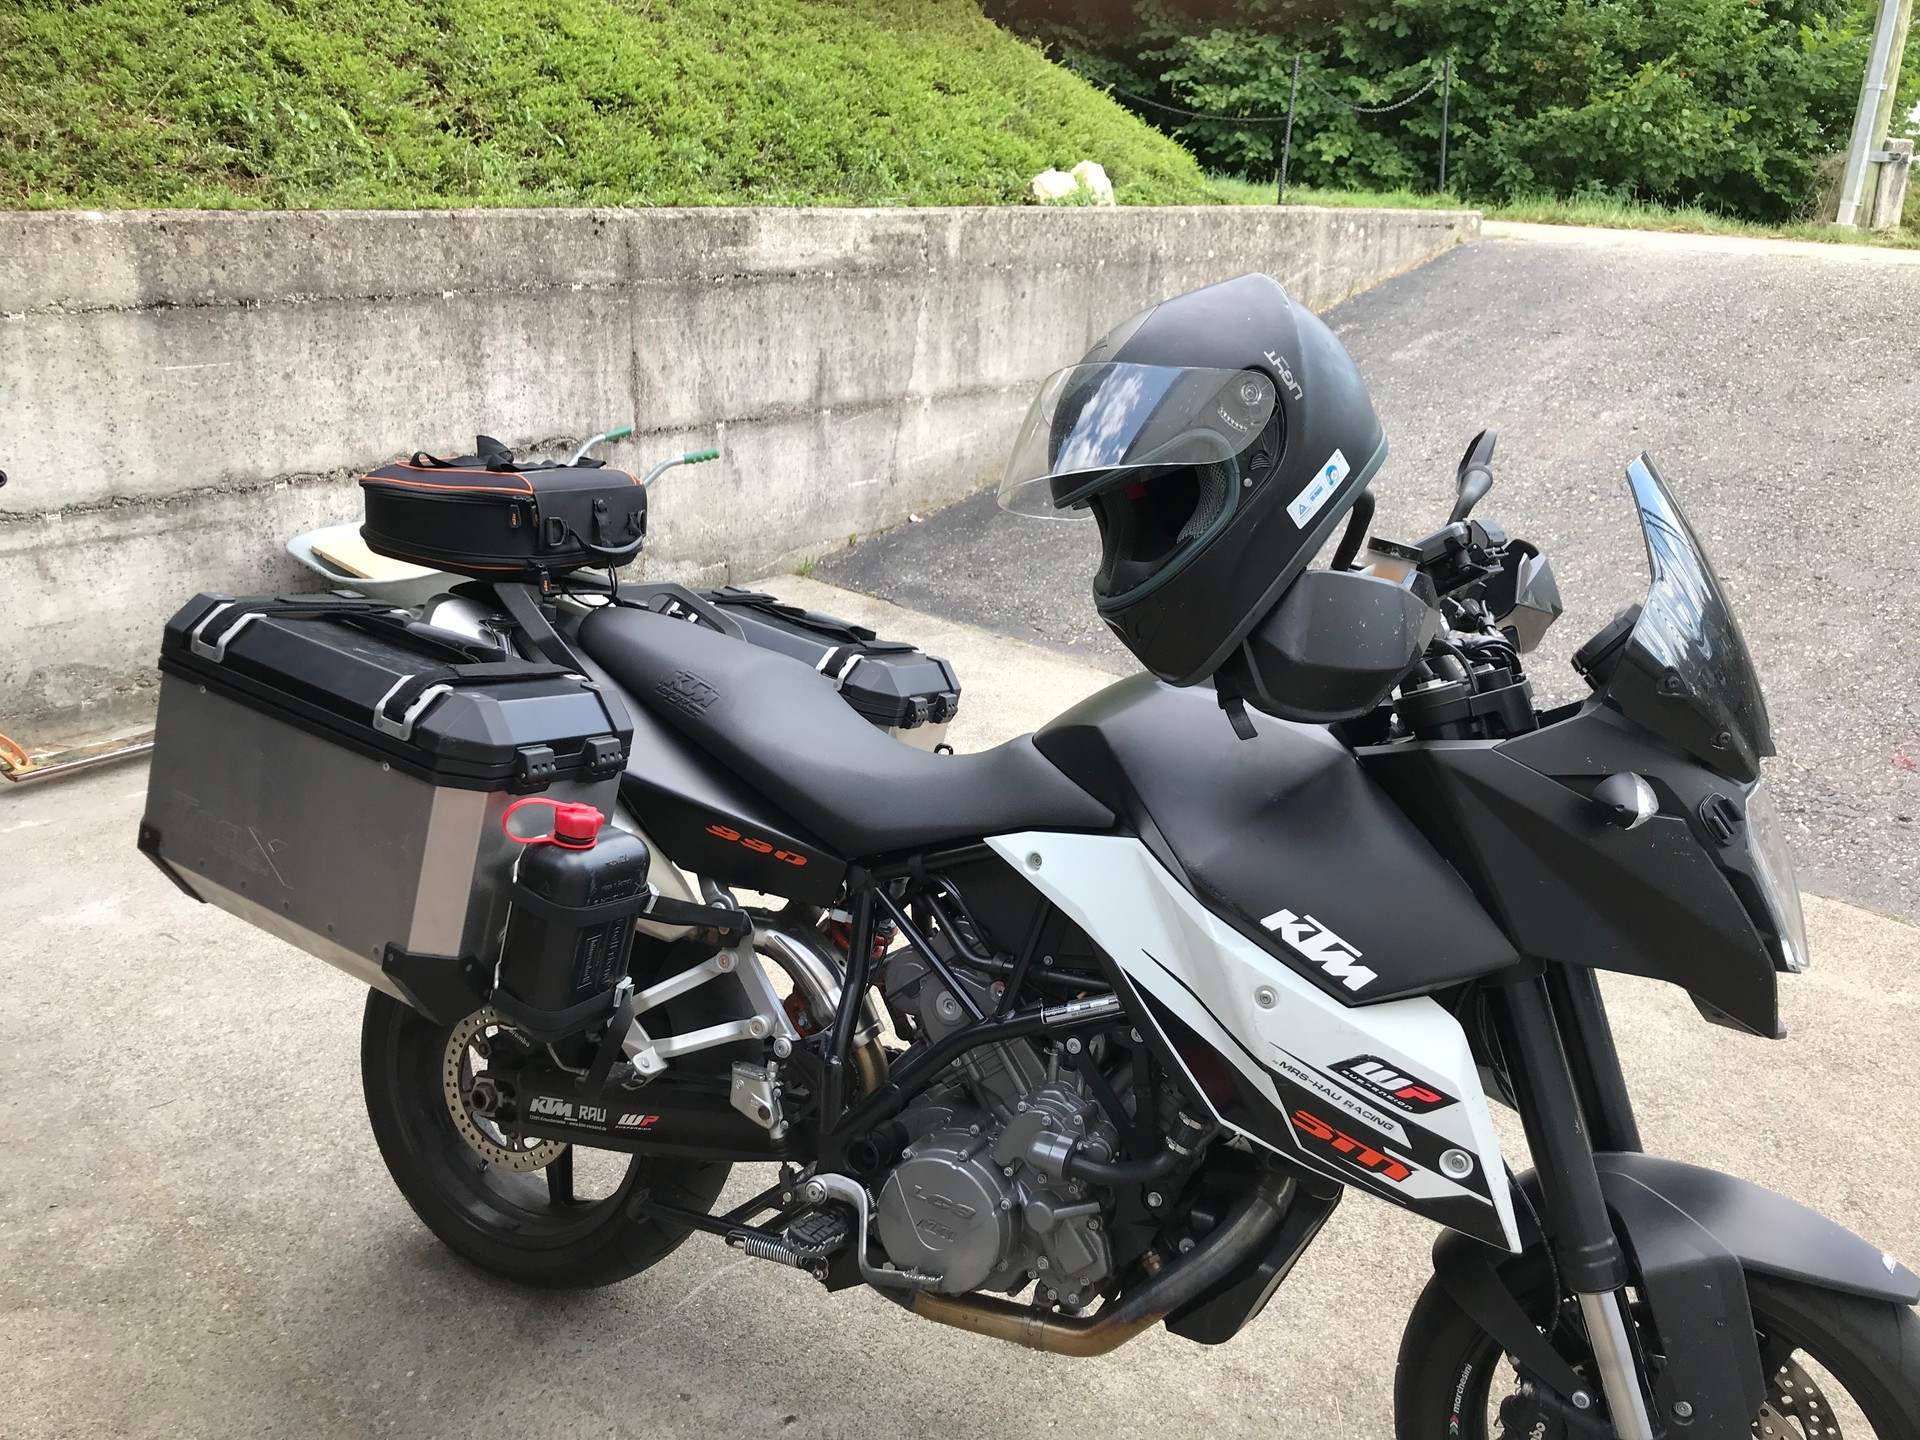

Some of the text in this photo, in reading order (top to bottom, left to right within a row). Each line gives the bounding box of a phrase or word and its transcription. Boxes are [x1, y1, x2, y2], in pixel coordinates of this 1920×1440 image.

[704, 824, 809, 867] 990
[1259, 908, 1379, 992] KTM
[529, 1096, 574, 1118] KTM
[1342, 1099, 1396, 1132] RACING
[1453, 1363, 1473, 1414] marchesini
